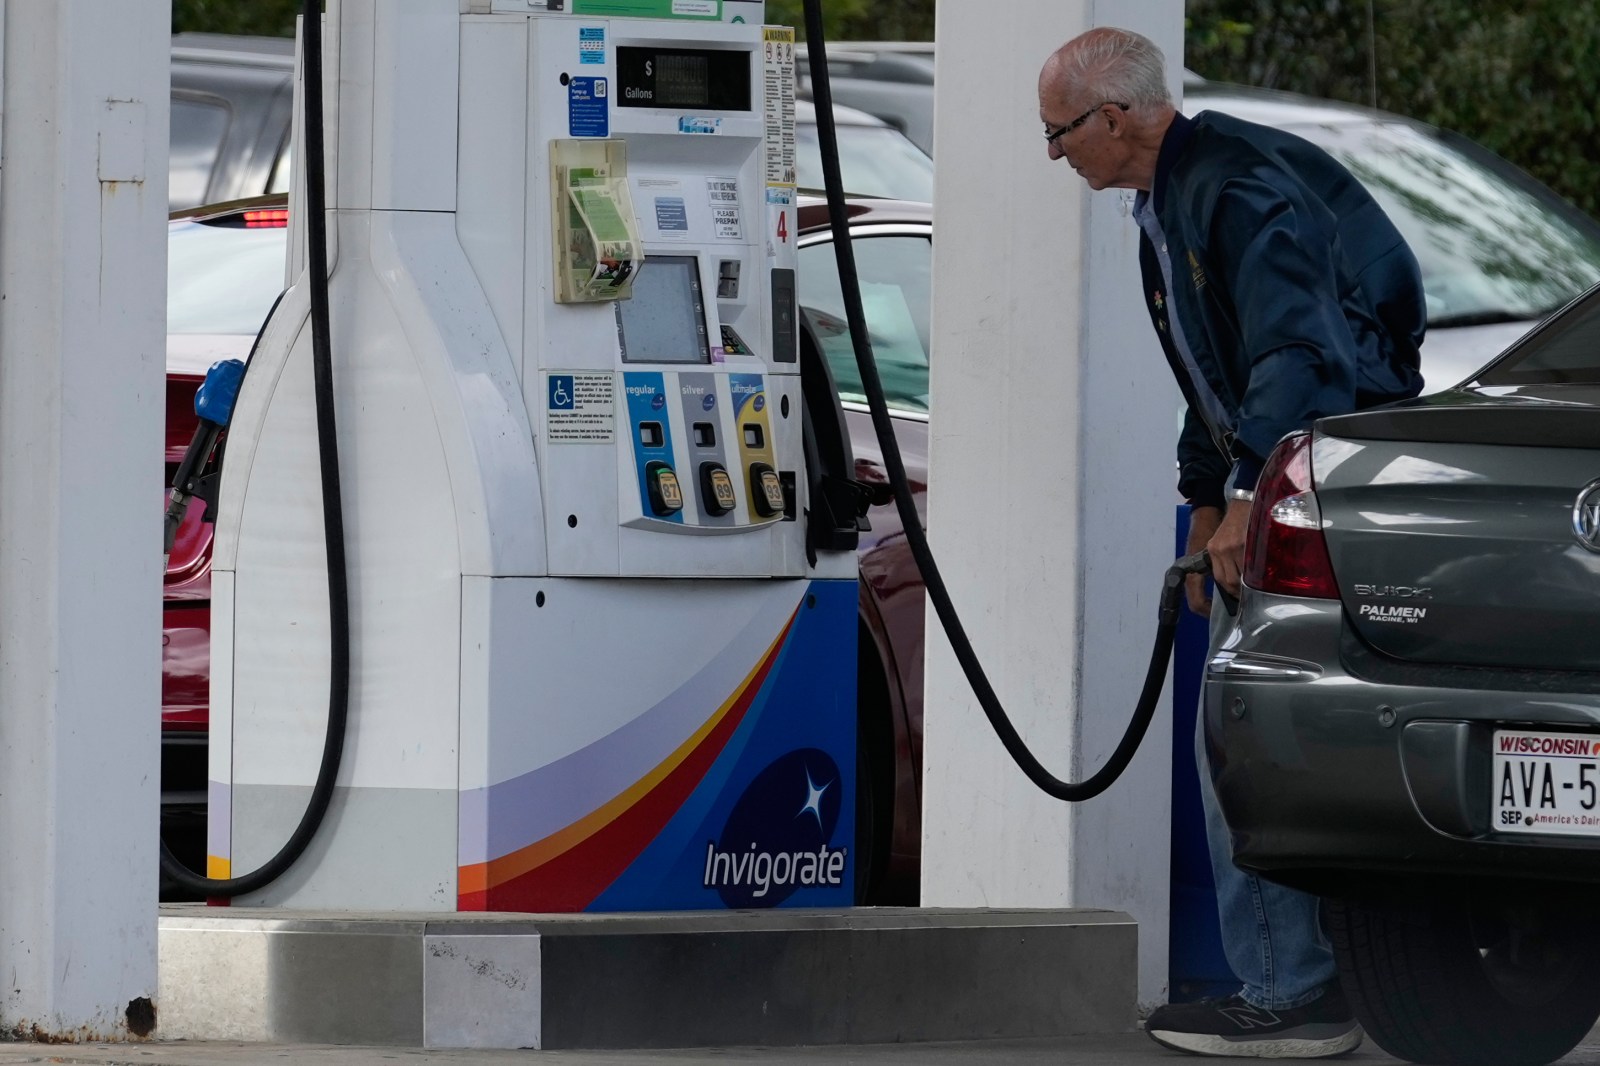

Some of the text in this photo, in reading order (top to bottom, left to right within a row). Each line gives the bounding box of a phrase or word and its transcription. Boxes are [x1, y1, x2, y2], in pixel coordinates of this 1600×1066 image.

[645, 60, 653, 77] $
[625, 86, 653, 99] Gallons
[715, 217, 739, 225] PREPAY
[777, 210, 788, 243] 4
[625, 384, 656, 397] regular
[681, 384, 705, 395] silver
[731, 384, 757, 394] ultimate
[662, 483, 677, 499] 87
[715, 484, 731, 499] 89
[766, 484, 782, 500] 93
[1354, 584, 1432, 598] BUICK
[1360, 604, 1427, 618] PALMEN
[1369, 615, 1405, 624] RACINE,
[1500, 736, 1591, 756] WISCONSIN
[1500, 761, 1597, 811] AVA-5
[1501, 810, 1523, 825] SEP
[1534, 813, 1579, 825] America's
[703, 841, 845, 898] Invigorate
